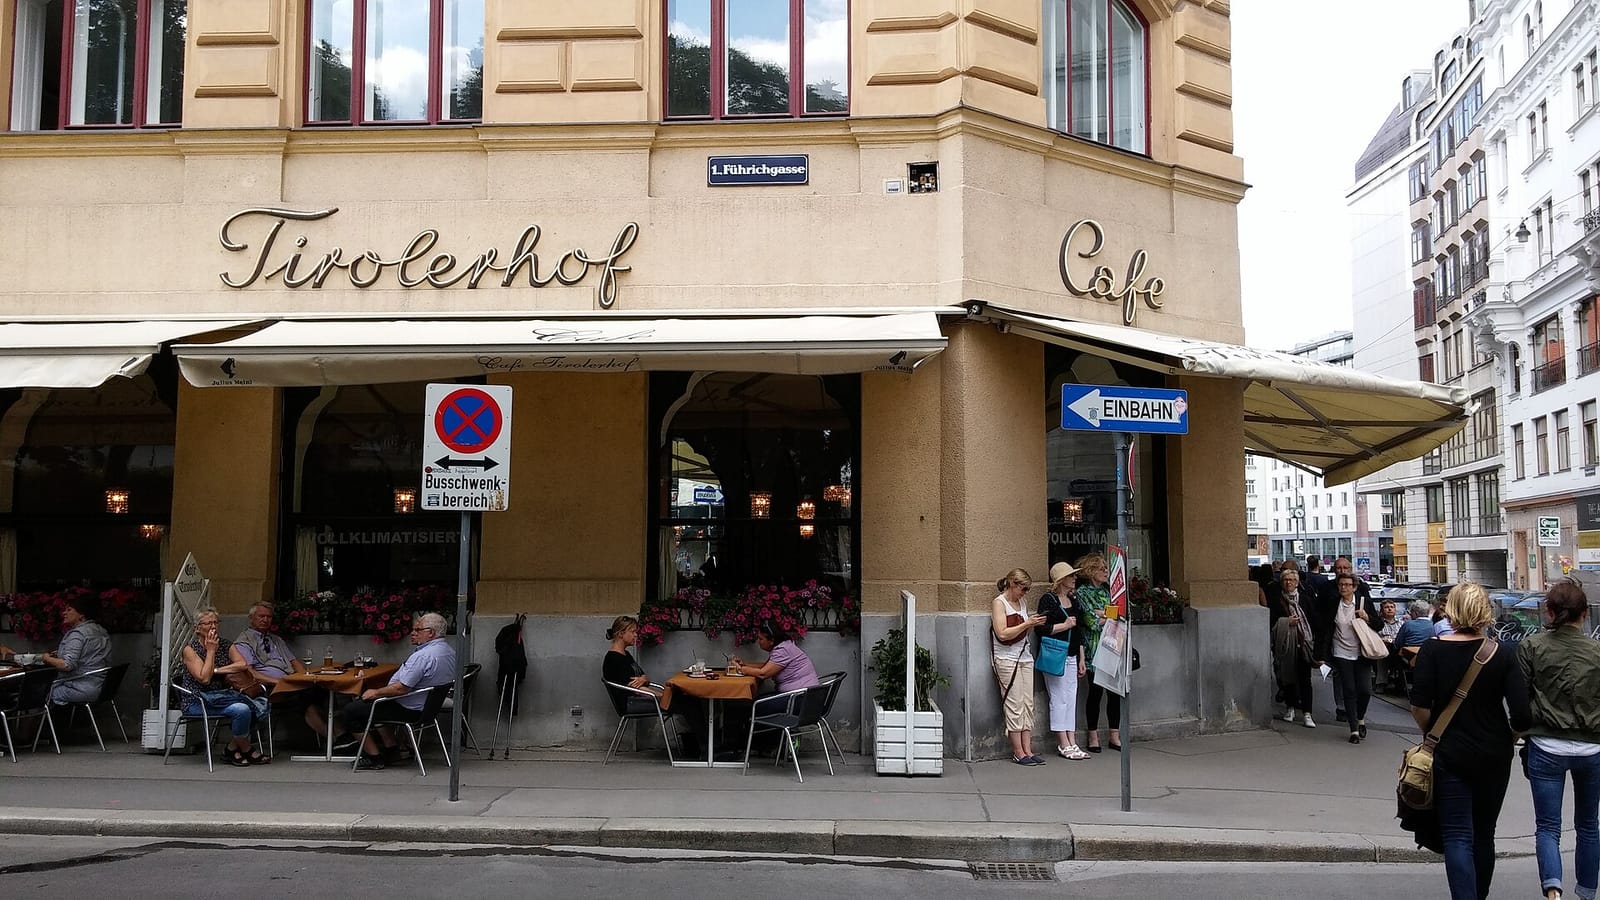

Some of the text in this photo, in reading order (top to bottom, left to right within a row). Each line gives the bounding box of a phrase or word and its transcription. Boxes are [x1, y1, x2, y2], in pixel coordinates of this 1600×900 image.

[219, 207, 639, 309] Tirolerhof
[1059, 219, 1165, 326] Cafe
[533, 355, 640, 372] Tirolerhof
[1103, 399, 1173, 420] EINBAHN
[426, 474, 506, 490] Busschwenk-
[443, 492, 487, 507] bereich
